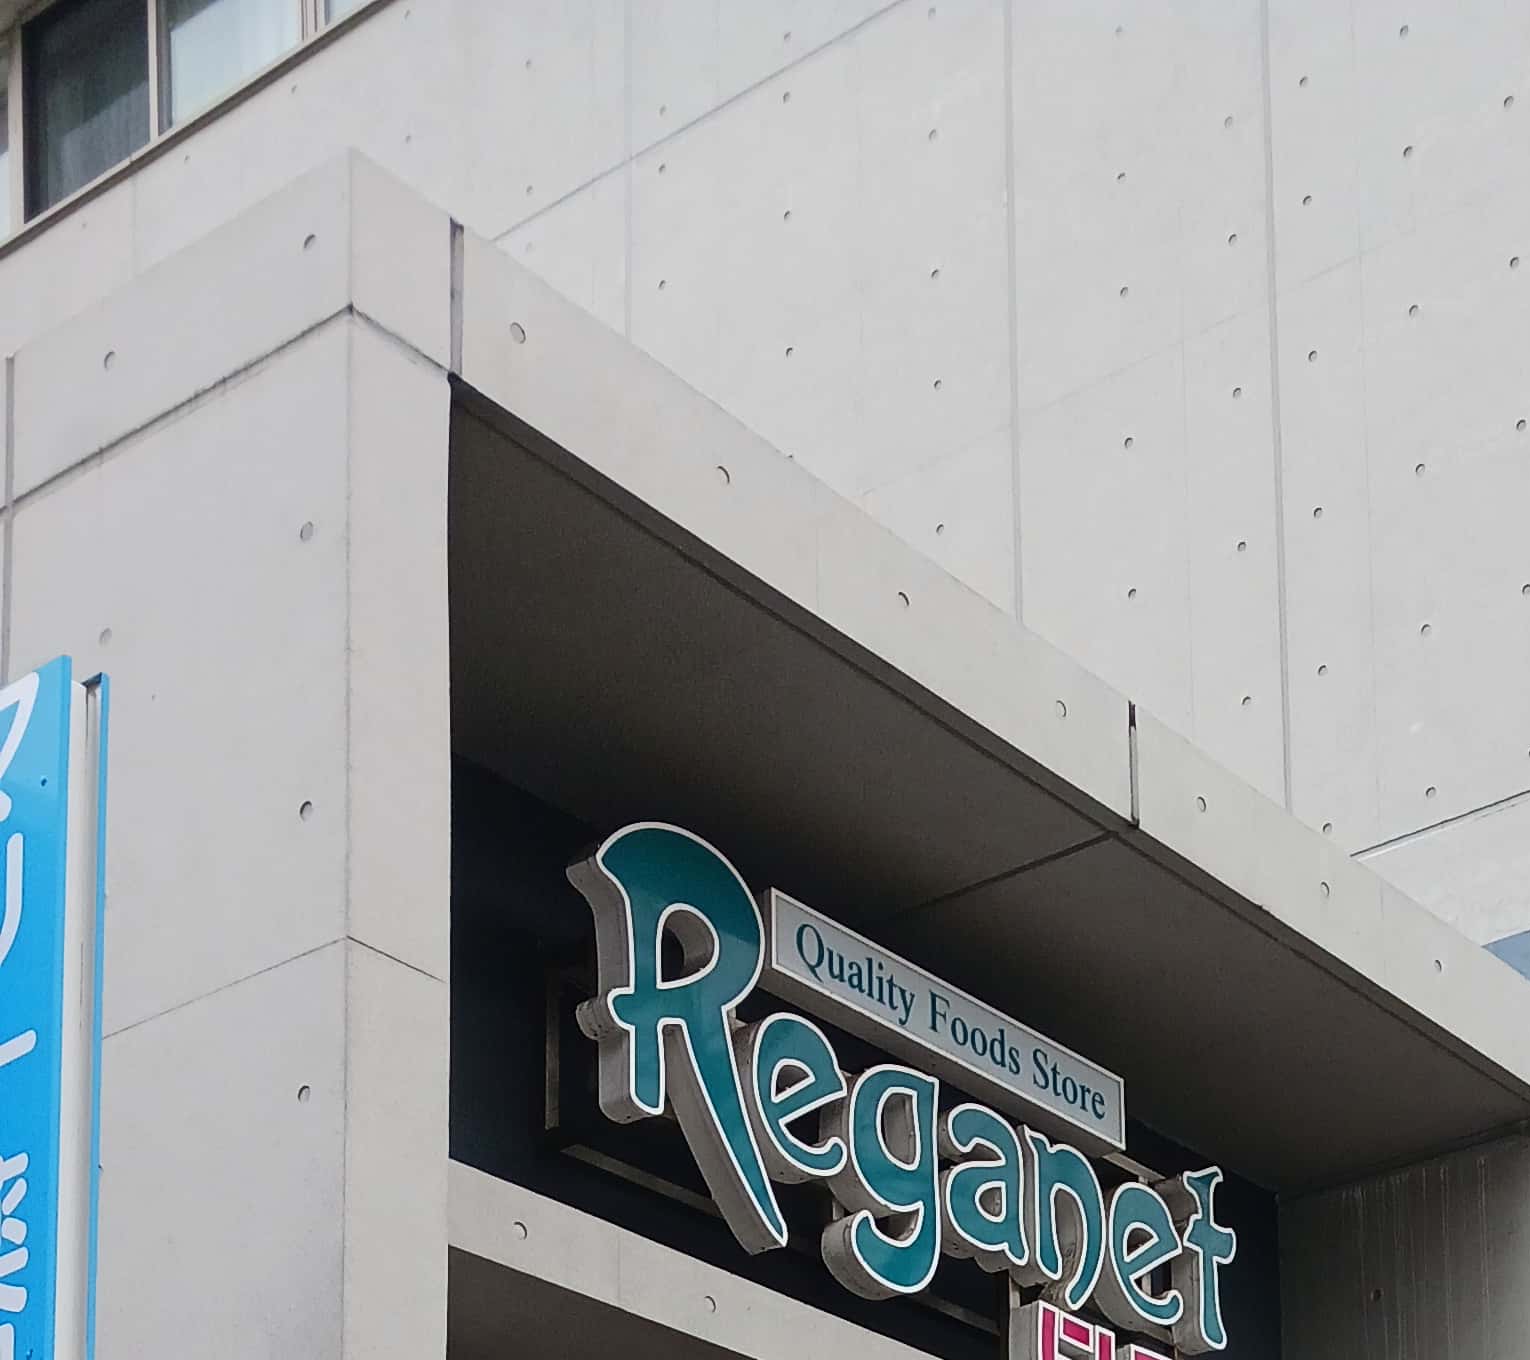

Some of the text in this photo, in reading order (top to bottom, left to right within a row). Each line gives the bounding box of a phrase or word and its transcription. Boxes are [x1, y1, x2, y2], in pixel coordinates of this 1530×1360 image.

[597, 821, 1237, 1350] Reganet
[795, 923, 1106, 1120] Quality Foods Store
